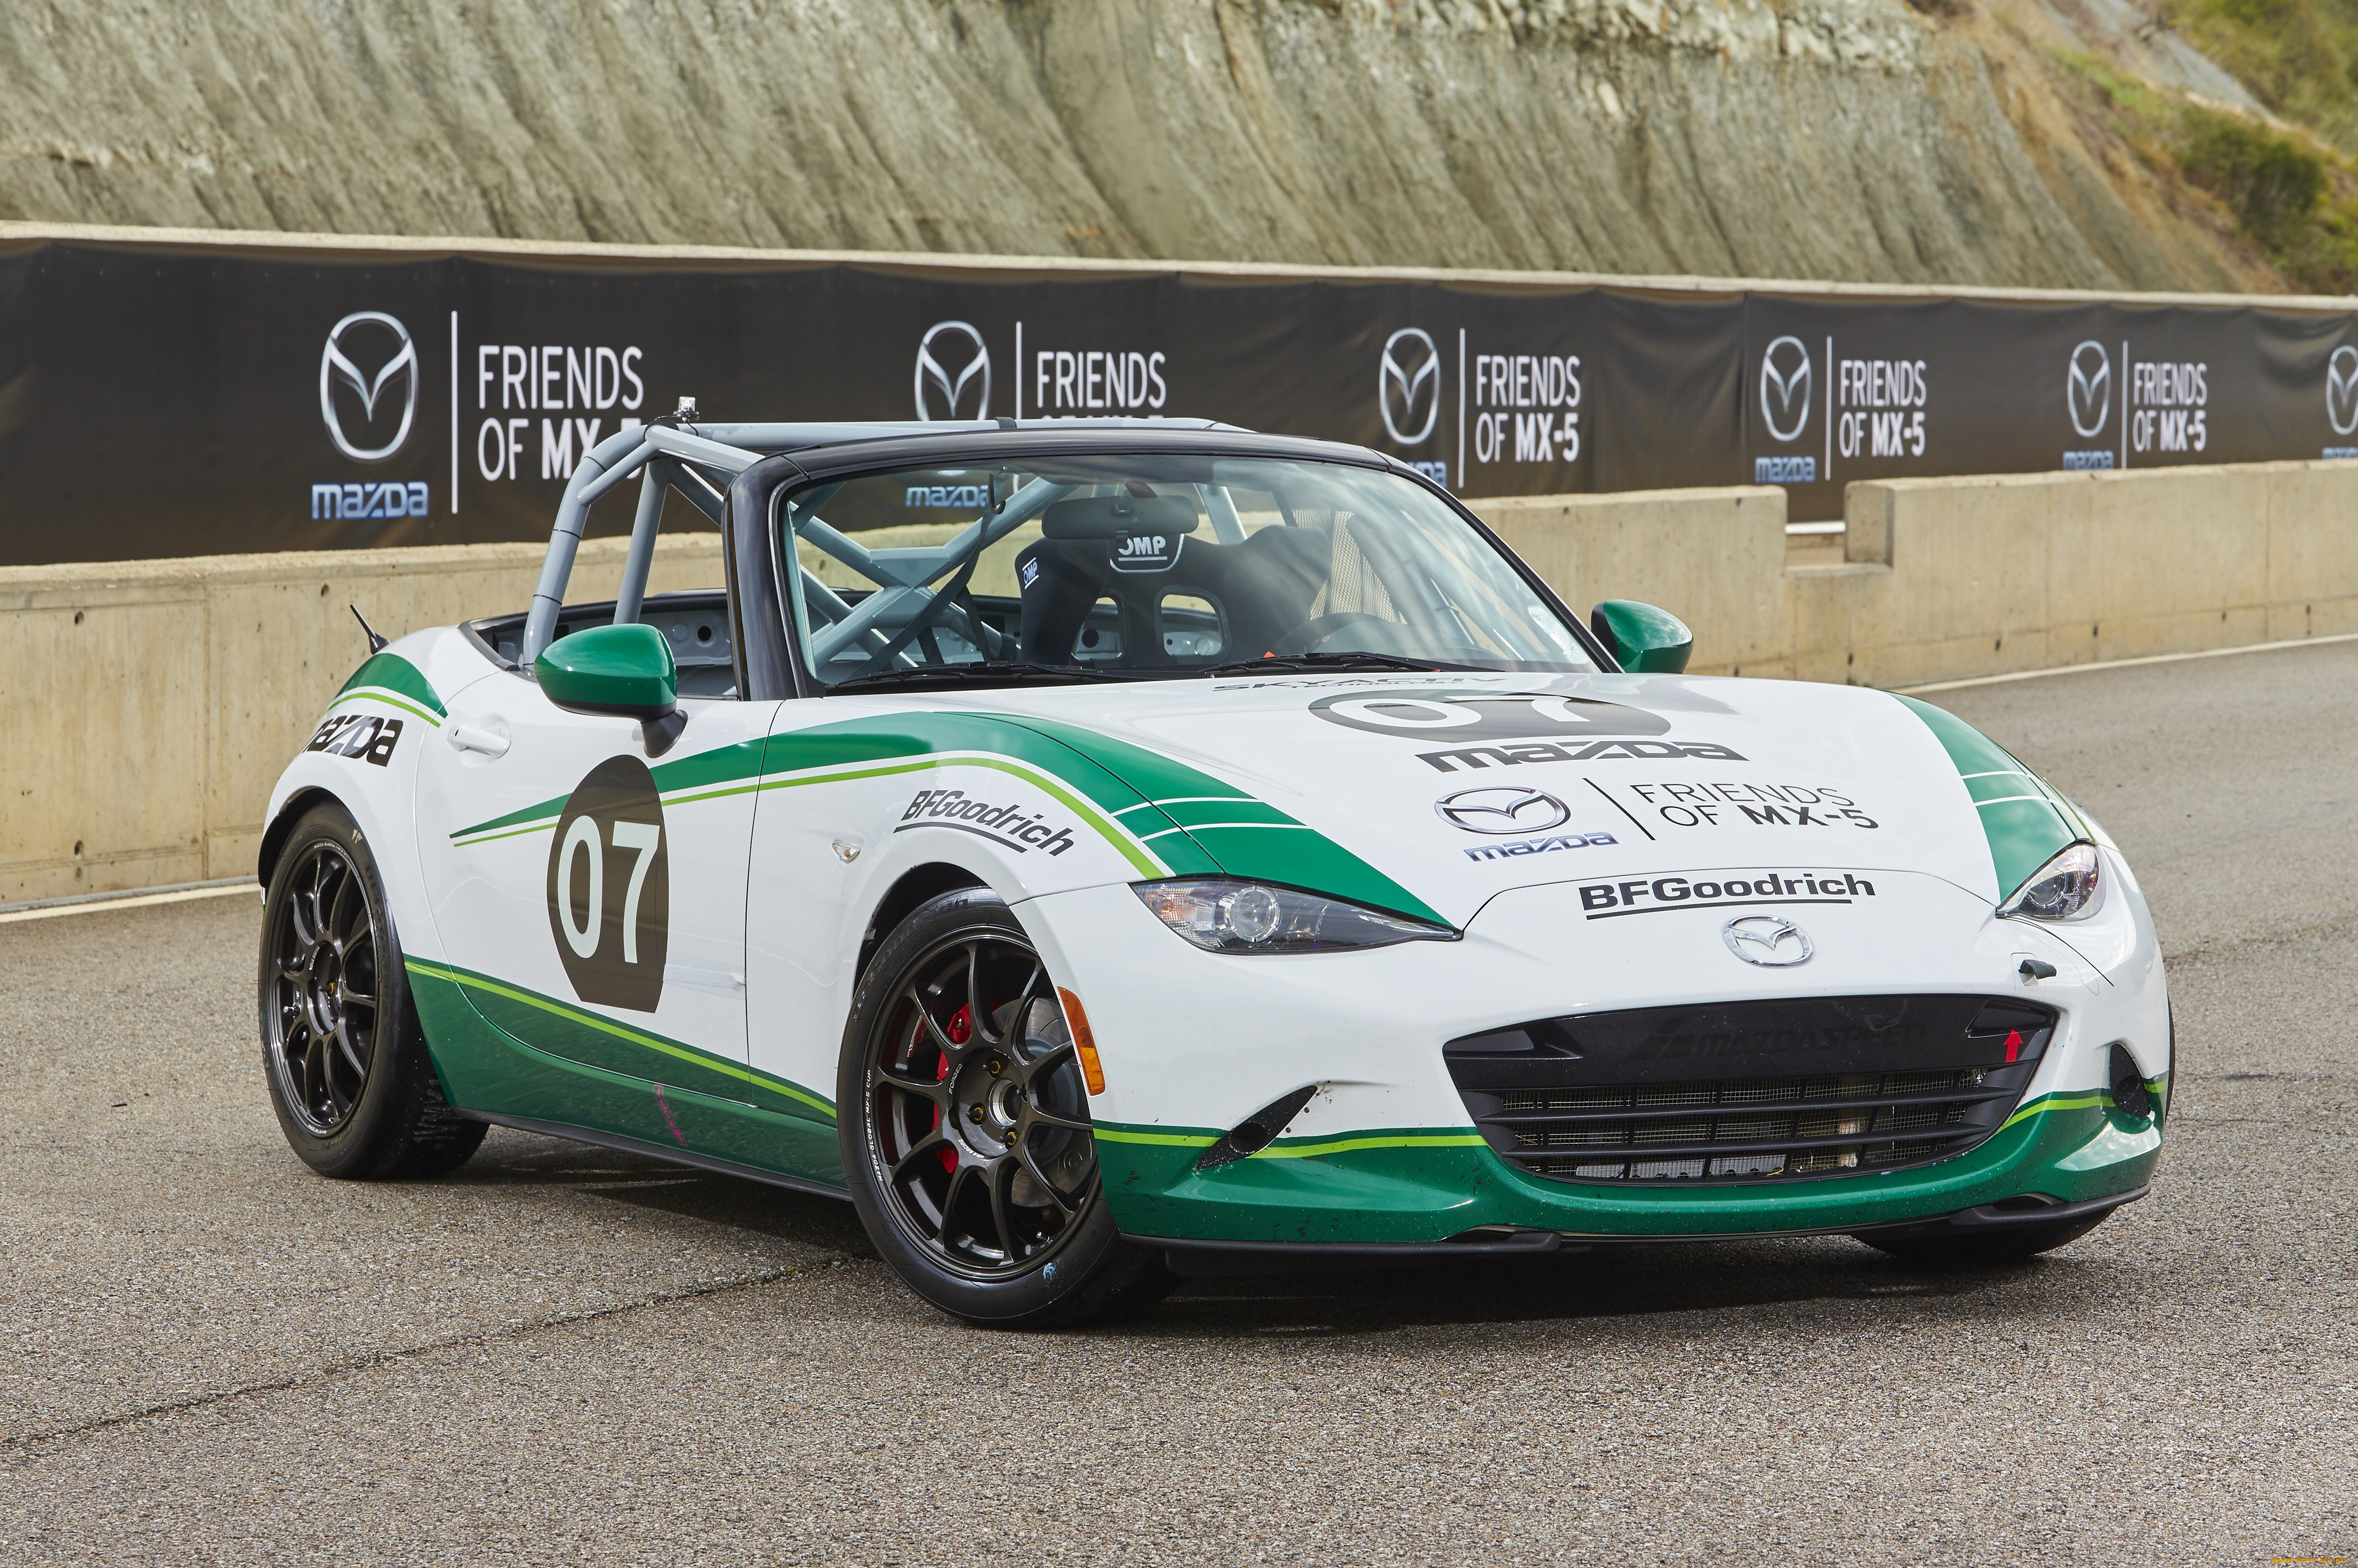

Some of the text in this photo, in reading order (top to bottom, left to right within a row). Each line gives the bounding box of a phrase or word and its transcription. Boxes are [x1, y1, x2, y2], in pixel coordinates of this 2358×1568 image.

[478, 345, 644, 409] FRIENDS
[1037, 352, 1166, 409] FRIENDS
[1477, 355, 1581, 406] FRIENDS
[1840, 360, 1927, 407] FRIENDS
[2133, 363, 2207, 406] FRIENDS
[478, 418, 528, 481] OF
[1475, 412, 1580, 463] OF MX-5
[1839, 412, 1926, 458] OF MX-5
[2133, 410, 2207, 452] OF MX-5
[1023, 561, 1038, 585] OMP
[1212, 677, 1508, 692] SKYACTIV
[1329, 695, 1592, 728] 07
[1629, 782, 1857, 807] FRIENDS
[900, 789, 1075, 857] BFGoodrich
[1660, 805, 1880, 829] OF MX-5
[557, 815, 660, 965] 07
[1577, 873, 1877, 911] BFGoodrich
[948, 1063, 963, 1094] FORGED
[866, 1117, 875, 1151] GLOBAL
[873, 1154, 884, 1181] MAZDA
